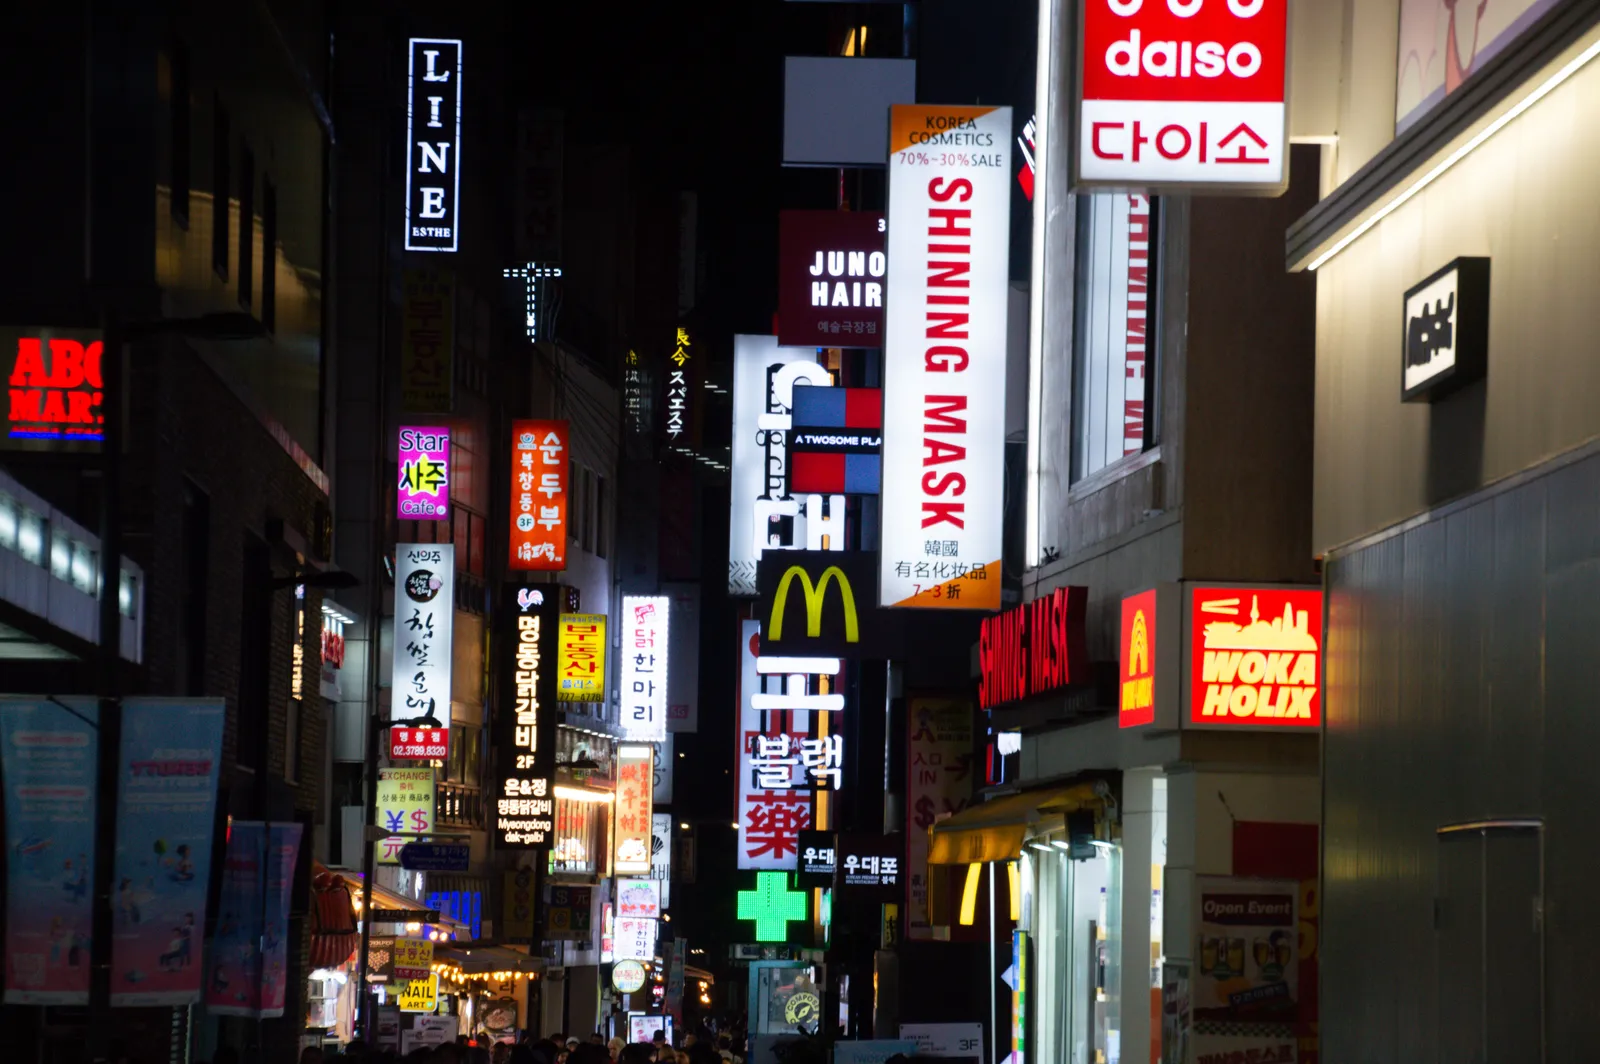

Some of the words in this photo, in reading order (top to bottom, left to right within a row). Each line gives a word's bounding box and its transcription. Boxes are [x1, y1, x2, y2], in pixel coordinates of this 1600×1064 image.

[1105, 28, 1261, 78] daiso
[926, 116, 977, 130] KOREA
[417, 50, 450, 218] LINE
[909, 131, 993, 147] COSMETICS
[1092, 120, 1269, 164] 다이소
[412, 227, 451, 238] ESTHE
[809, 250, 886, 277] JUNO
[924, 176, 973, 373] SHINING
[811, 281, 882, 307] HAIR
[400, 429, 448, 451] Star
[795, 435, 803, 444] A
[804, 435, 859, 446] TWOSOME
[920, 395, 967, 531] MASK
[399, 460, 446, 491] 사주
[519, 452, 534, 512] 북창동
[537, 431, 563, 531] 순두부
[401, 500, 435, 515] Cafe
[519, 518, 532, 527] 3F
[407, 550, 441, 564] 신의주
[924, 540, 958, 557] 韓國
[895, 560, 987, 580] 有名化妆品
[947, 583, 962, 599] 折
[564, 624, 599, 678] 부동산
[979, 602, 1027, 711] SHINING
[1030, 586, 1070, 695] MASK
[633, 628, 656, 722] 닭한마리
[1202, 651, 1316, 685] WOKA
[515, 615, 541, 752] 명동닭갈비
[1202, 684, 1317, 718] HOLIX
[516, 755, 535, 768] 2F
[749, 733, 843, 790] 블랙
[380, 772, 430, 780] EXCHANGE
[504, 778, 547, 797] 은&정
[498, 800, 552, 816] 명동닭갈비
[498, 818, 551, 833] Myeongdong
[745, 789, 808, 860] 藥
[843, 854, 898, 875] 우대포
[1204, 901, 1244, 916] Open
[1248, 901, 1291, 914] Event
[402, 986, 434, 999] NAIL
[959, 1039, 979, 1051] 3F
